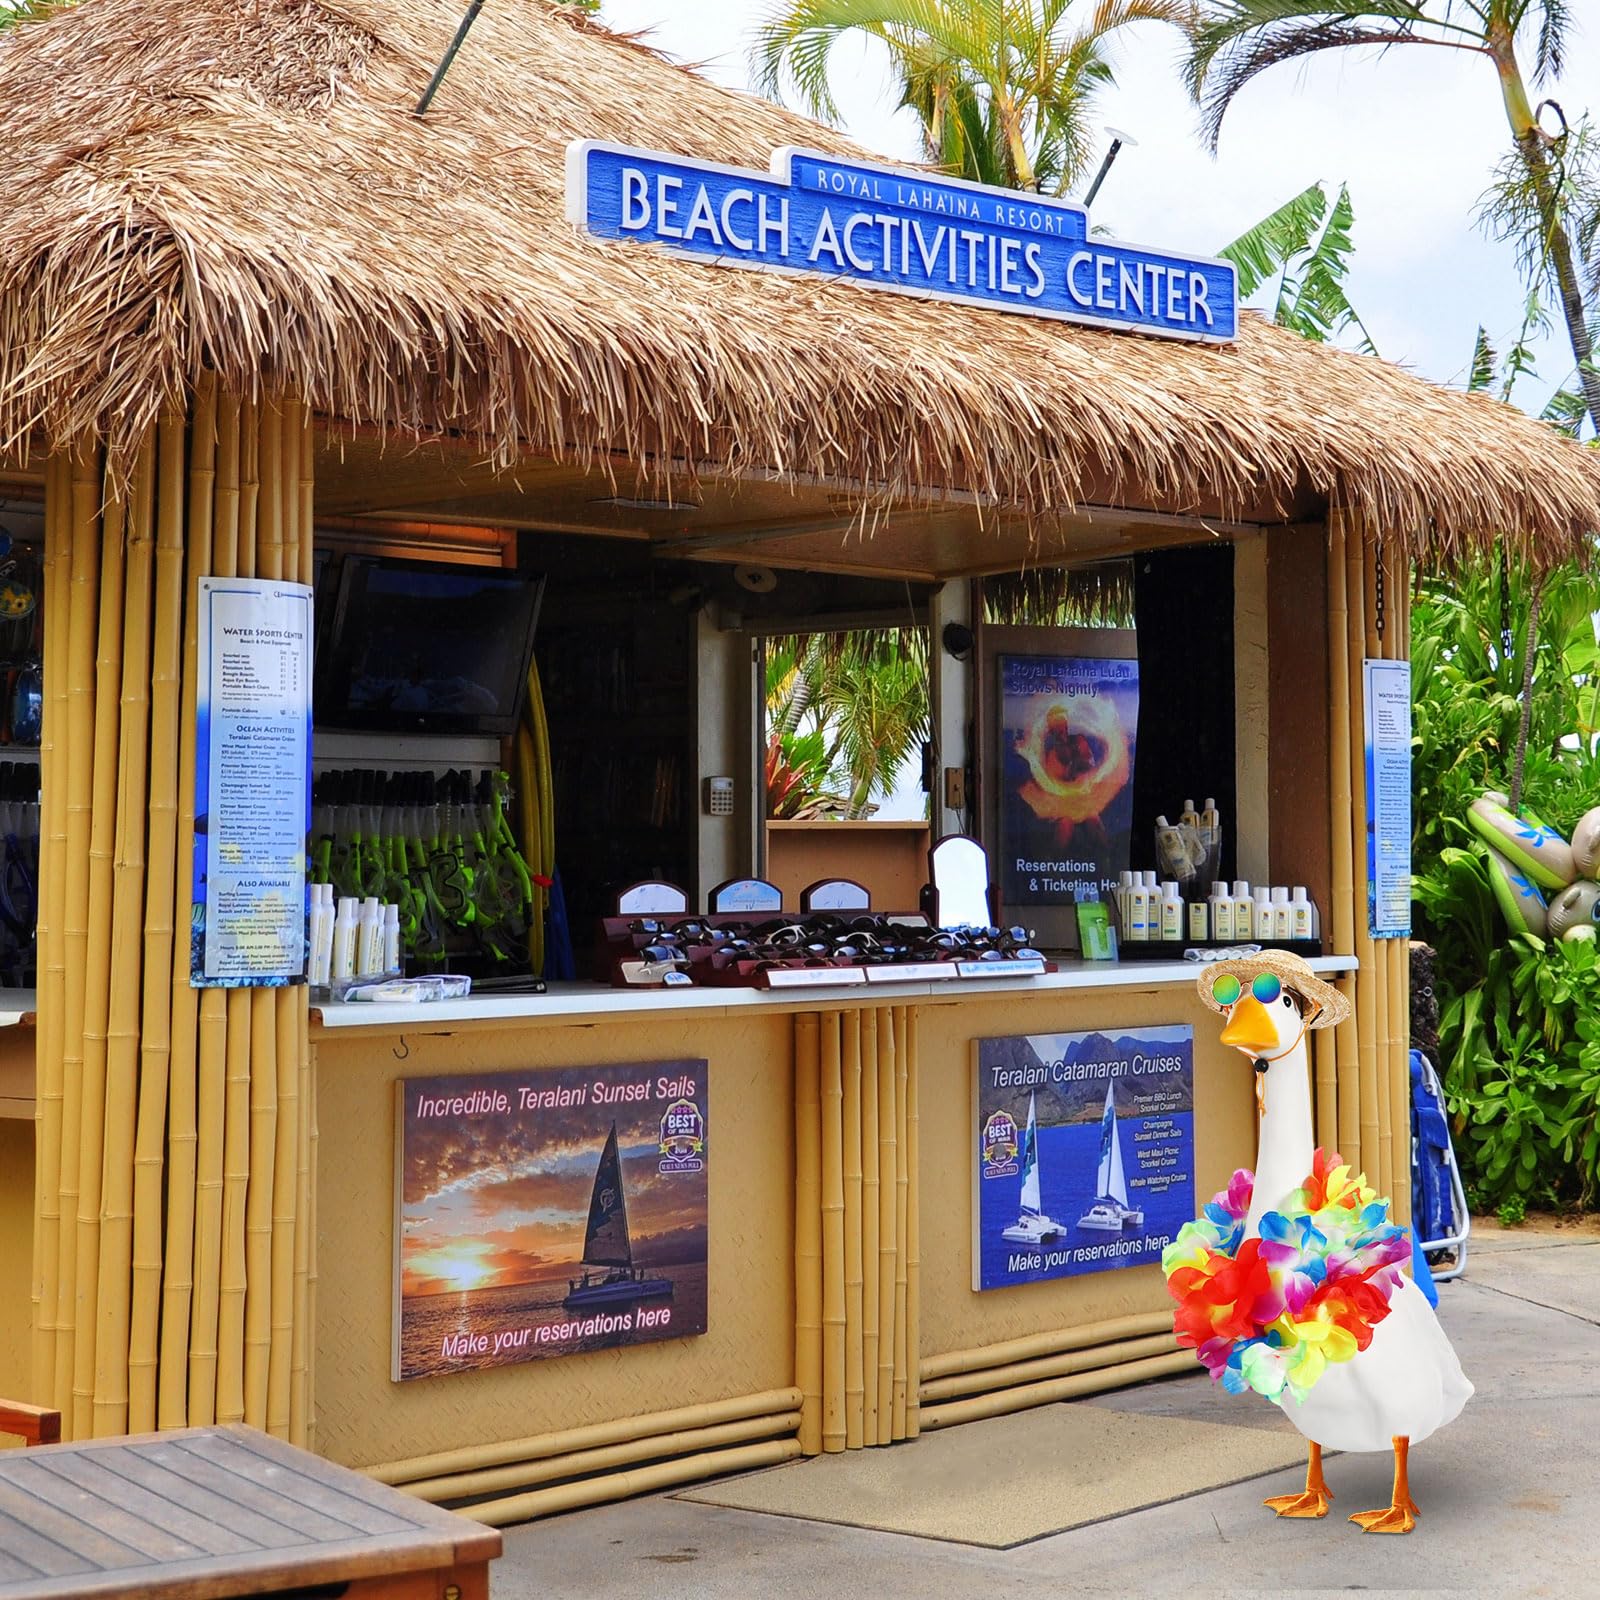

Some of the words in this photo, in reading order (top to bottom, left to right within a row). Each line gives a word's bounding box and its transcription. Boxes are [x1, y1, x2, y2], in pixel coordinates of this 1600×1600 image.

[817, 168, 882, 201] ROYAL
[995, 203, 1065, 235] RESORT
[620, 167, 790, 257] BEACH
[809, 207, 1047, 298] ACTIVITIES
[1066, 250, 1215, 326] CENTER
[223, 627, 254, 636] WATER
[255, 628, 282, 638] SPORTS
[283, 630, 303, 640] CENTER
[1055, 681, 1099, 698] Nightly
[236, 724, 262, 733] OCEAN
[263, 726, 295, 735] ACTIVITIES
[1016, 857, 1096, 873] Reservations
[237, 880, 257, 888] ALSO
[258, 880, 291, 888] AVAILABLE
[1028, 877, 1039, 892] &
[1041, 877, 1097, 892] Ticketing
[991, 1062, 1050, 1088] Teralani
[1052, 1058, 1129, 1083] Catamaran
[1131, 1053, 1182, 1075] Cruises
[416, 1091, 512, 1119] Incredible,
[517, 1083, 588, 1111] Teralani
[591, 1080, 652, 1105] Sunset
[655, 1074, 696, 1100] Sails
[1133, 1094, 1153, 1103] Premier
[1153, 1092, 1167, 1102] BBQ
[1167, 1091, 1182, 1100] Lunch
[1139, 1103, 1159, 1113] Snorkel
[1160, 1102, 1176, 1111] Cruise
[667, 1113, 697, 1129] BEST
[1143, 1119, 1173, 1130] Champagne
[988, 1122, 1013, 1138] BEST
[1134, 1131, 1152, 1142] Sunset
[1152, 1129, 1169, 1139] Dinner
[1169, 1127, 1182, 1137] Sails
[1137, 1149, 1151, 1159] West
[1151, 1148, 1164, 1158] Maui
[1164, 1146, 1180, 1156] Picnic
[1140, 1159, 1161, 1169] Snorkel
[1161, 1157, 1177, 1166] Cruise
[1130, 1177, 1146, 1188] Whale
[1146, 1175, 1171, 1186] Watching
[1170, 1172, 1187, 1182] Cruise
[1008, 1252, 1041, 1273] Make
[1043, 1250, 1071, 1271] your
[1073, 1237, 1143, 1263] reservations
[1144, 1233, 1170, 1252] here
[441, 1334, 489, 1357] Make
[492, 1327, 532, 1355] your
[533, 1311, 633, 1343] reservations
[635, 1306, 672, 1329] here
